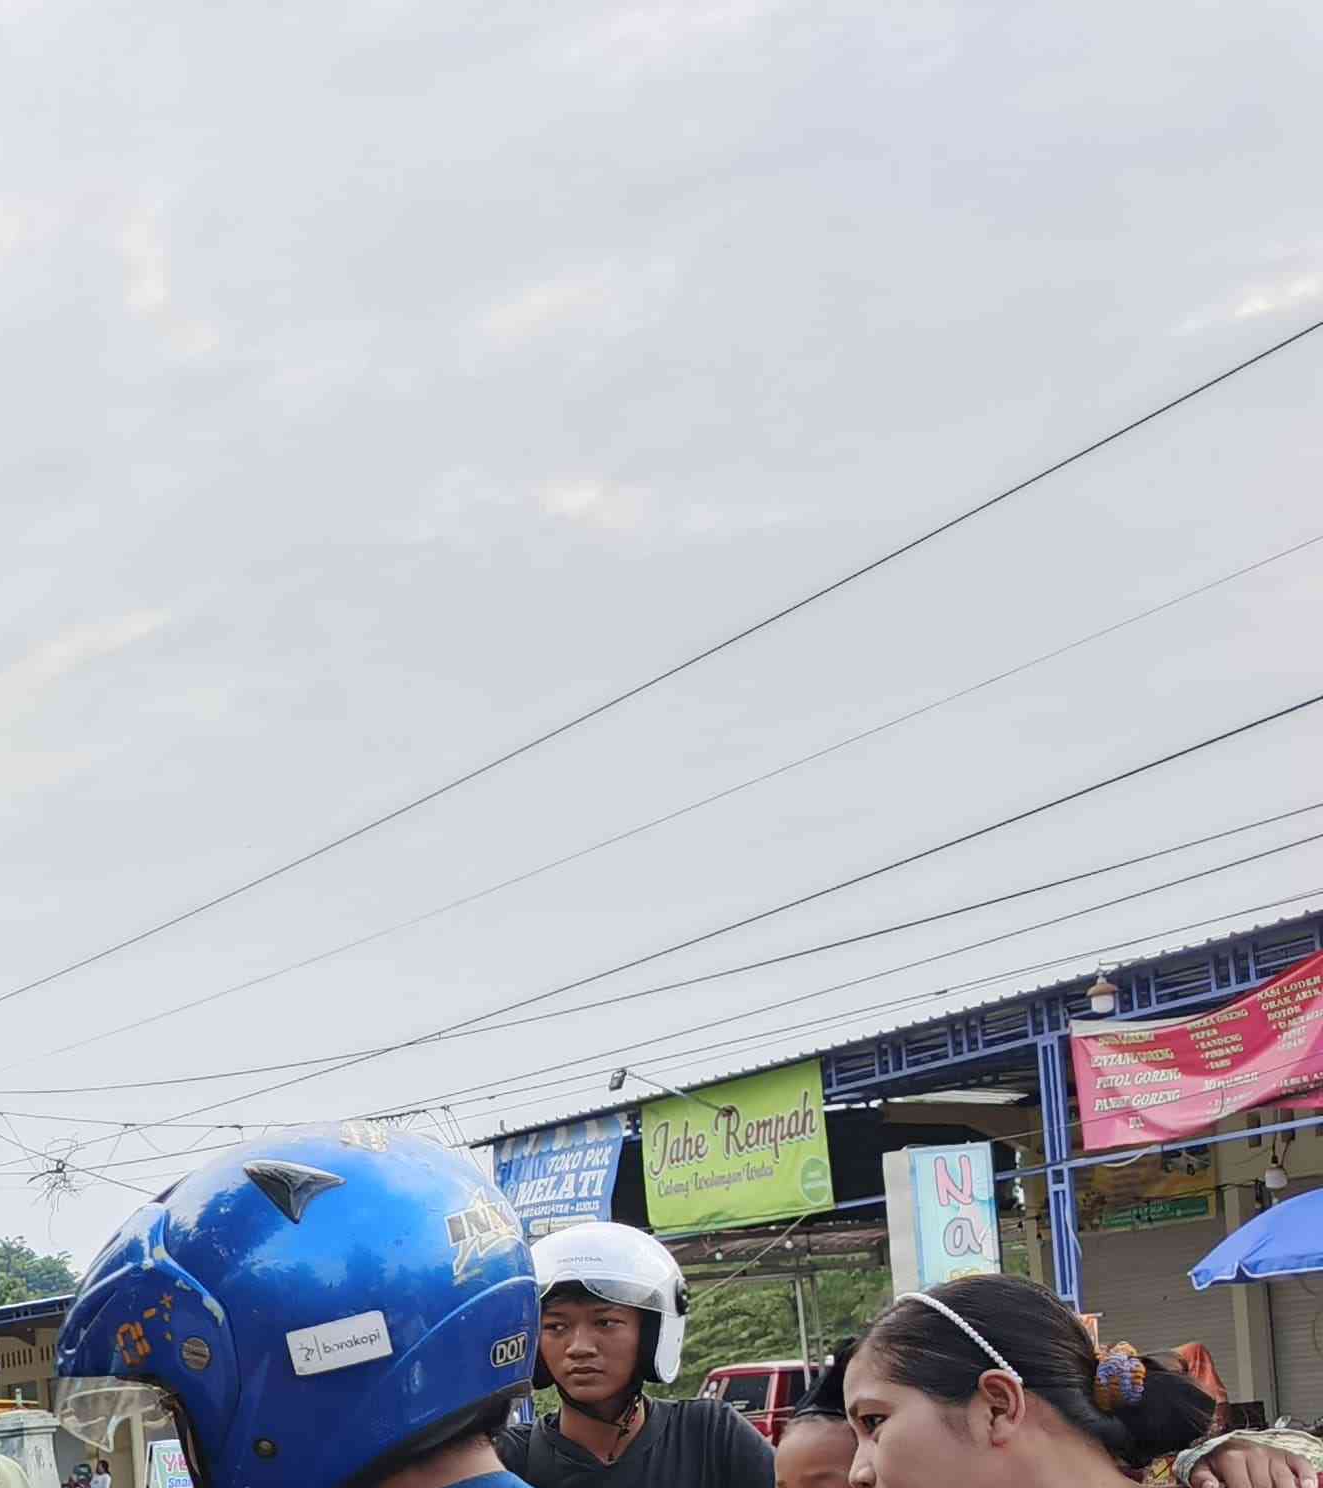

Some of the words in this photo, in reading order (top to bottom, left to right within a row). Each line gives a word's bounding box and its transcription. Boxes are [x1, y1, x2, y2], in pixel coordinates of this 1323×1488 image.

[650, 1119, 709, 1178] Jahe
[713, 1089, 817, 1161] Rempah
[546, 1151, 581, 1173] TOKO
[514, 1168, 607, 1208] MELATI
[494, 1335, 527, 1365] DOT
